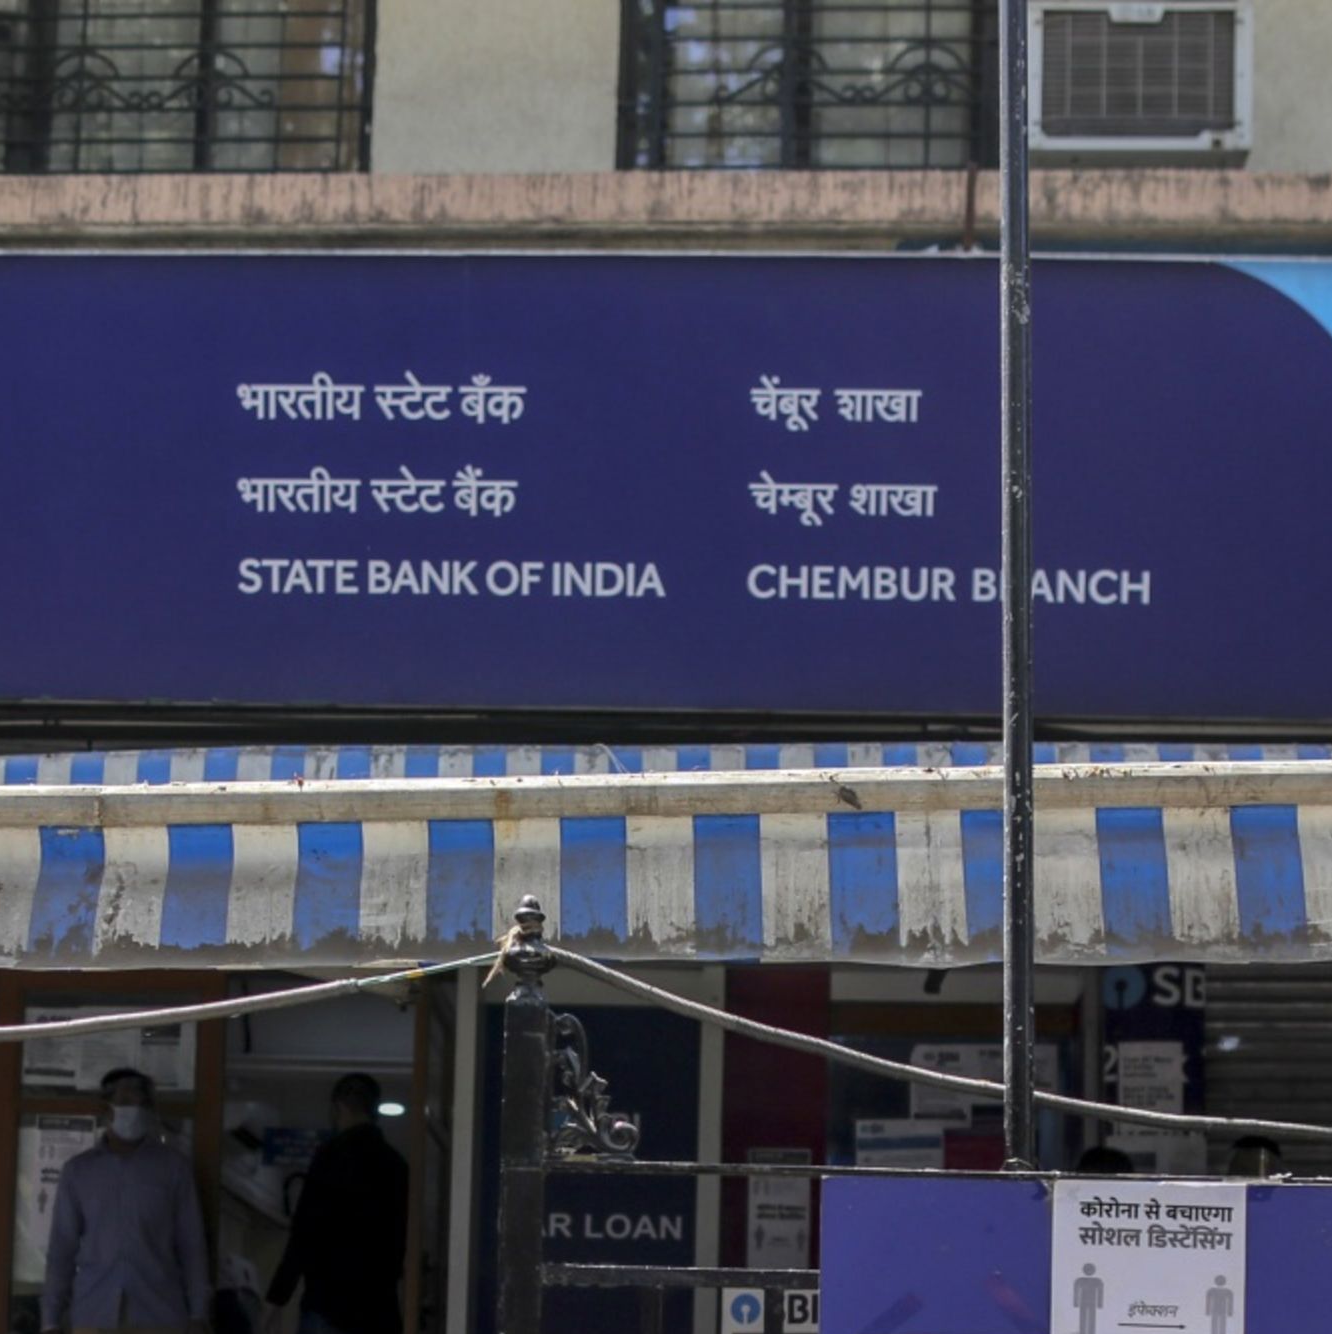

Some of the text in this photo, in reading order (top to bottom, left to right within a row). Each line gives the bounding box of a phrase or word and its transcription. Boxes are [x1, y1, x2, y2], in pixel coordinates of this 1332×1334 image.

[237, 370, 527, 424] भारतीय स्टेट बँक
[750, 375, 922, 431] चेंबूर शाखा
[237, 464, 518, 516] भारतीय स्टेट बैंक
[749, 471, 938, 526] चेम्बूर शाखा
[237, 558, 665, 598] STATE BANK OF INDIA
[747, 564, 1151, 605] CHEMBUR BANCH
[1153, 965, 1206, 1008] SB
[583, 1213, 682, 1241] LOAN
[1079, 1196, 1233, 1223] कोरोना से बचाएगा
[1078, 1221, 1142, 1247] सोशल
[784, 1294, 819, 1324] BI
